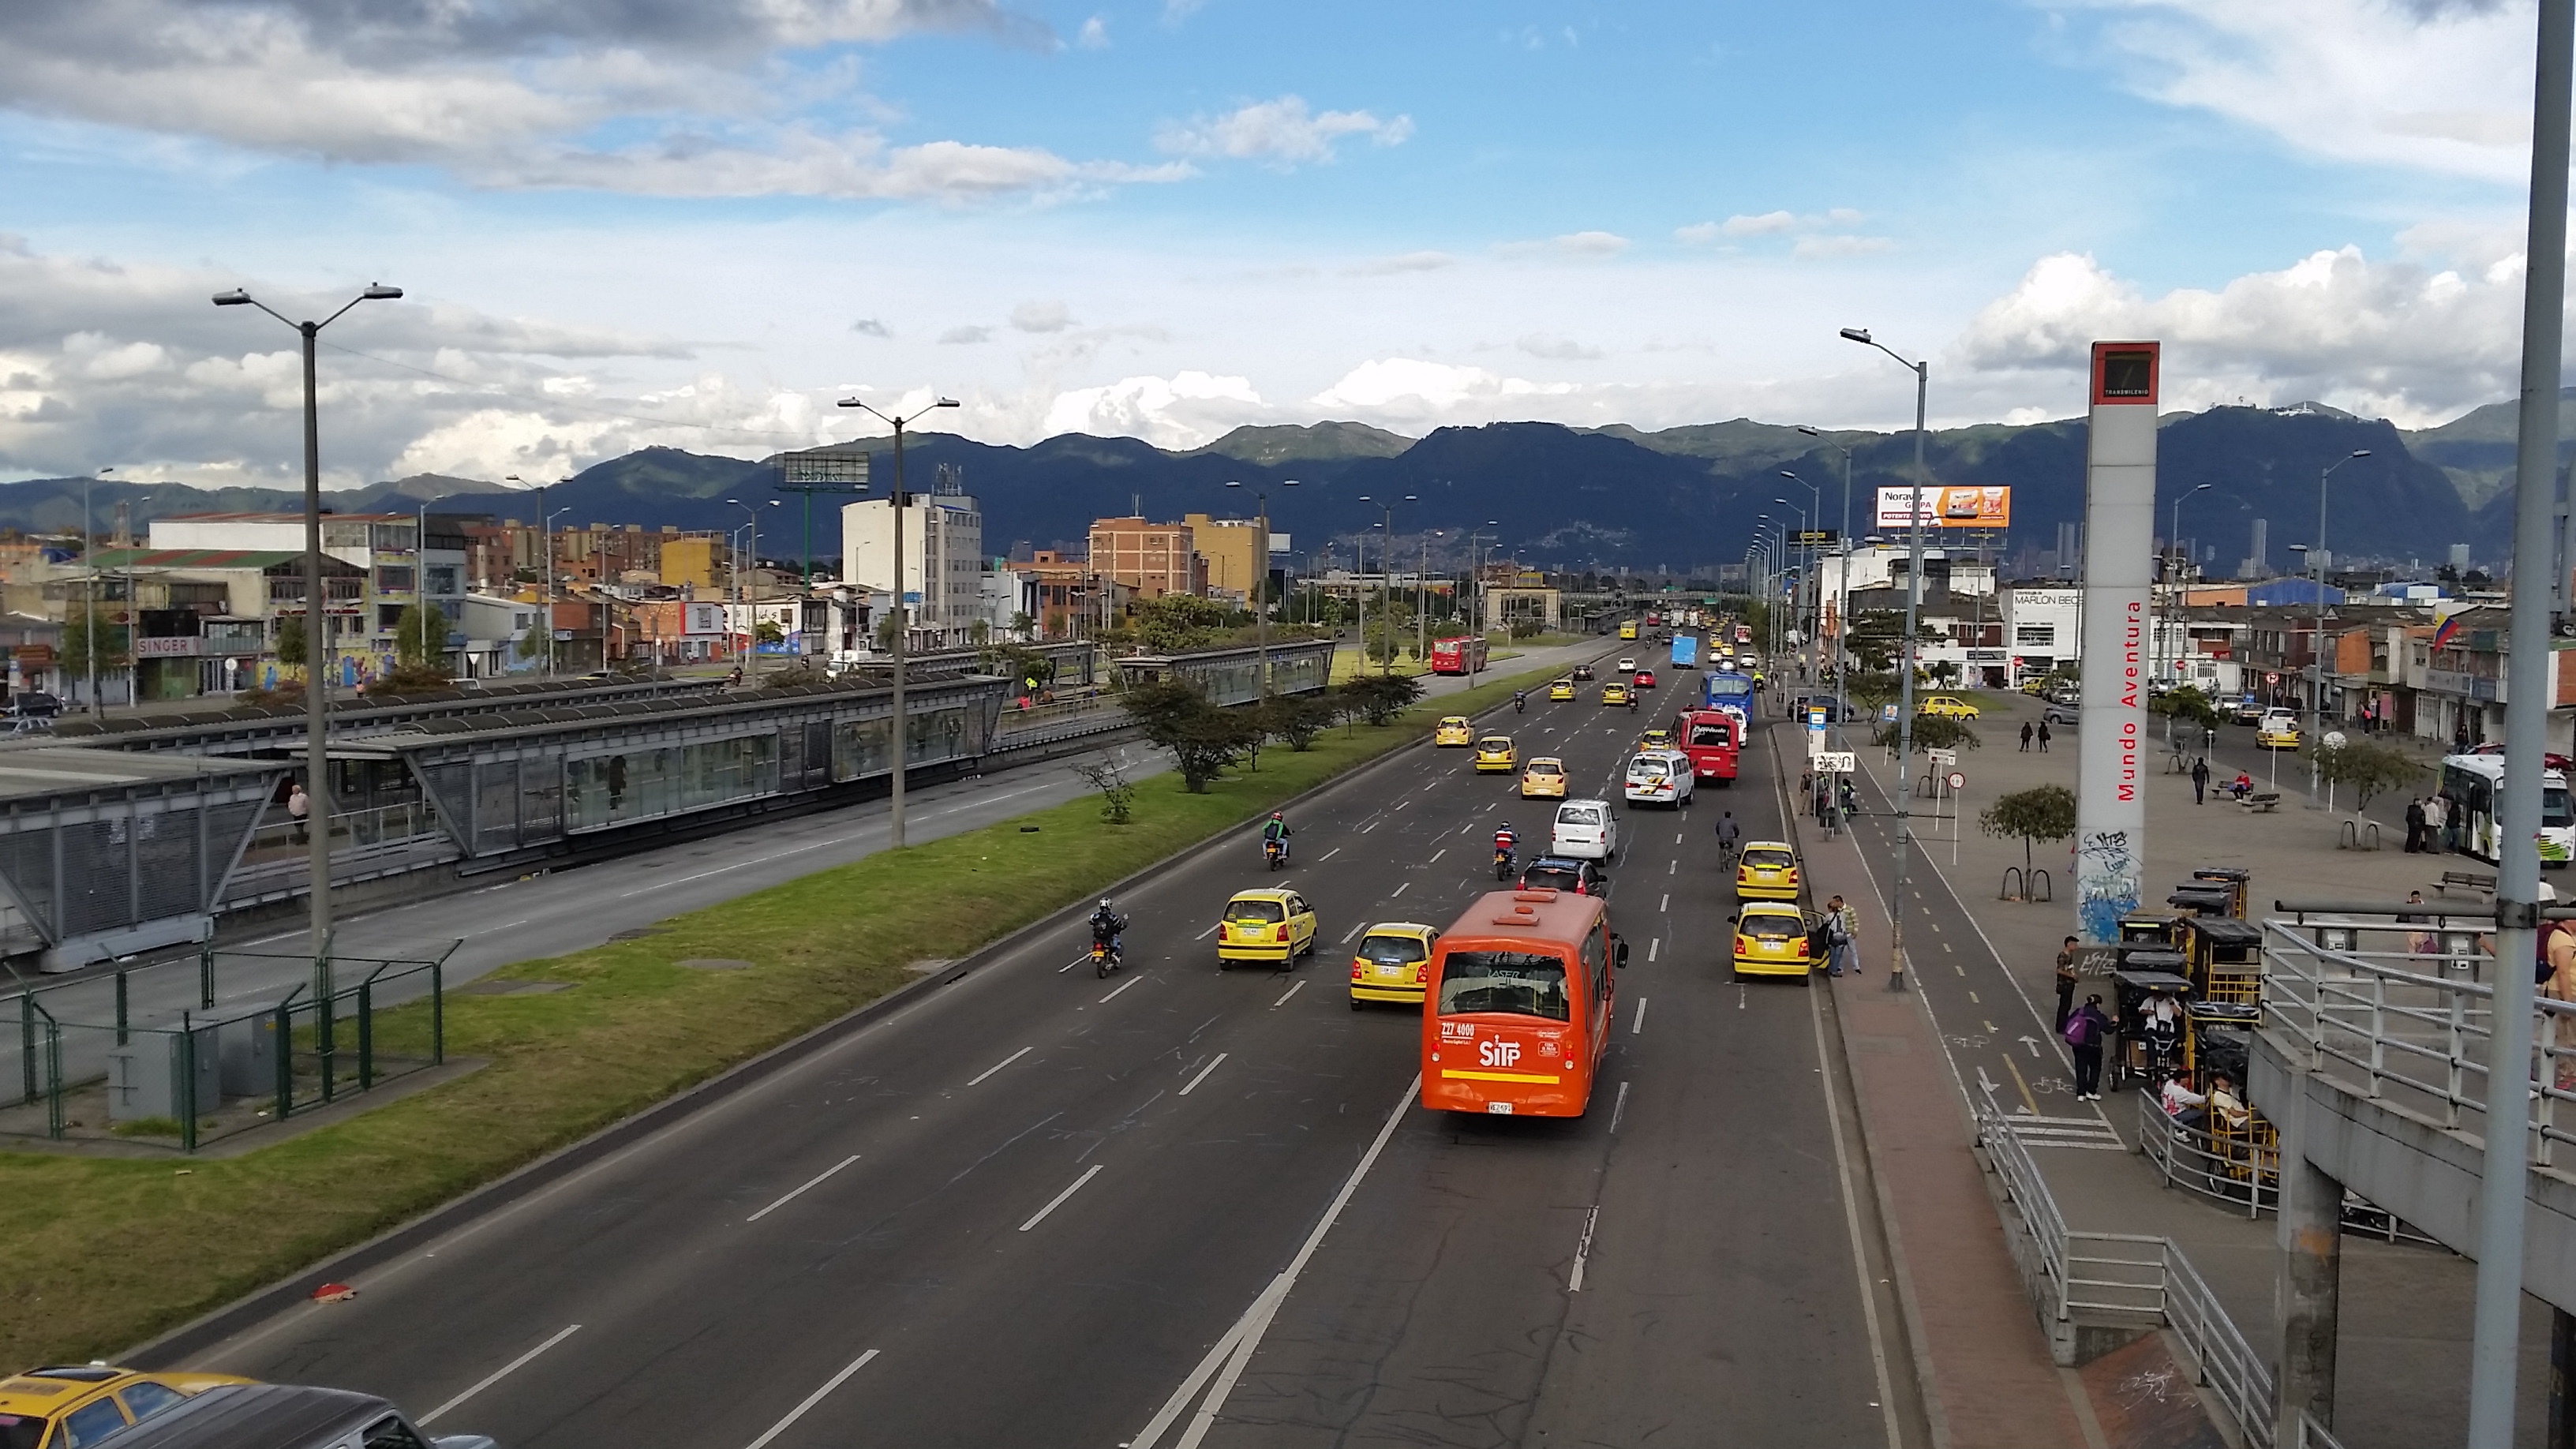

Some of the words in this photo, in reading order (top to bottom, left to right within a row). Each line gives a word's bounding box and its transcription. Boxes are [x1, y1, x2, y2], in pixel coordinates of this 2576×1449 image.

[1885, 492, 1926, 500] Noravr
[2015, 596, 2056, 605] MARLON
[139, 639, 187, 652] SINGER
[2121, 601, 2140, 708] Aventura
[2118, 723, 2136, 802] Mundo
[1441, 1022, 1455, 1035] Z27
[1456, 1024, 1475, 1036] 4000
